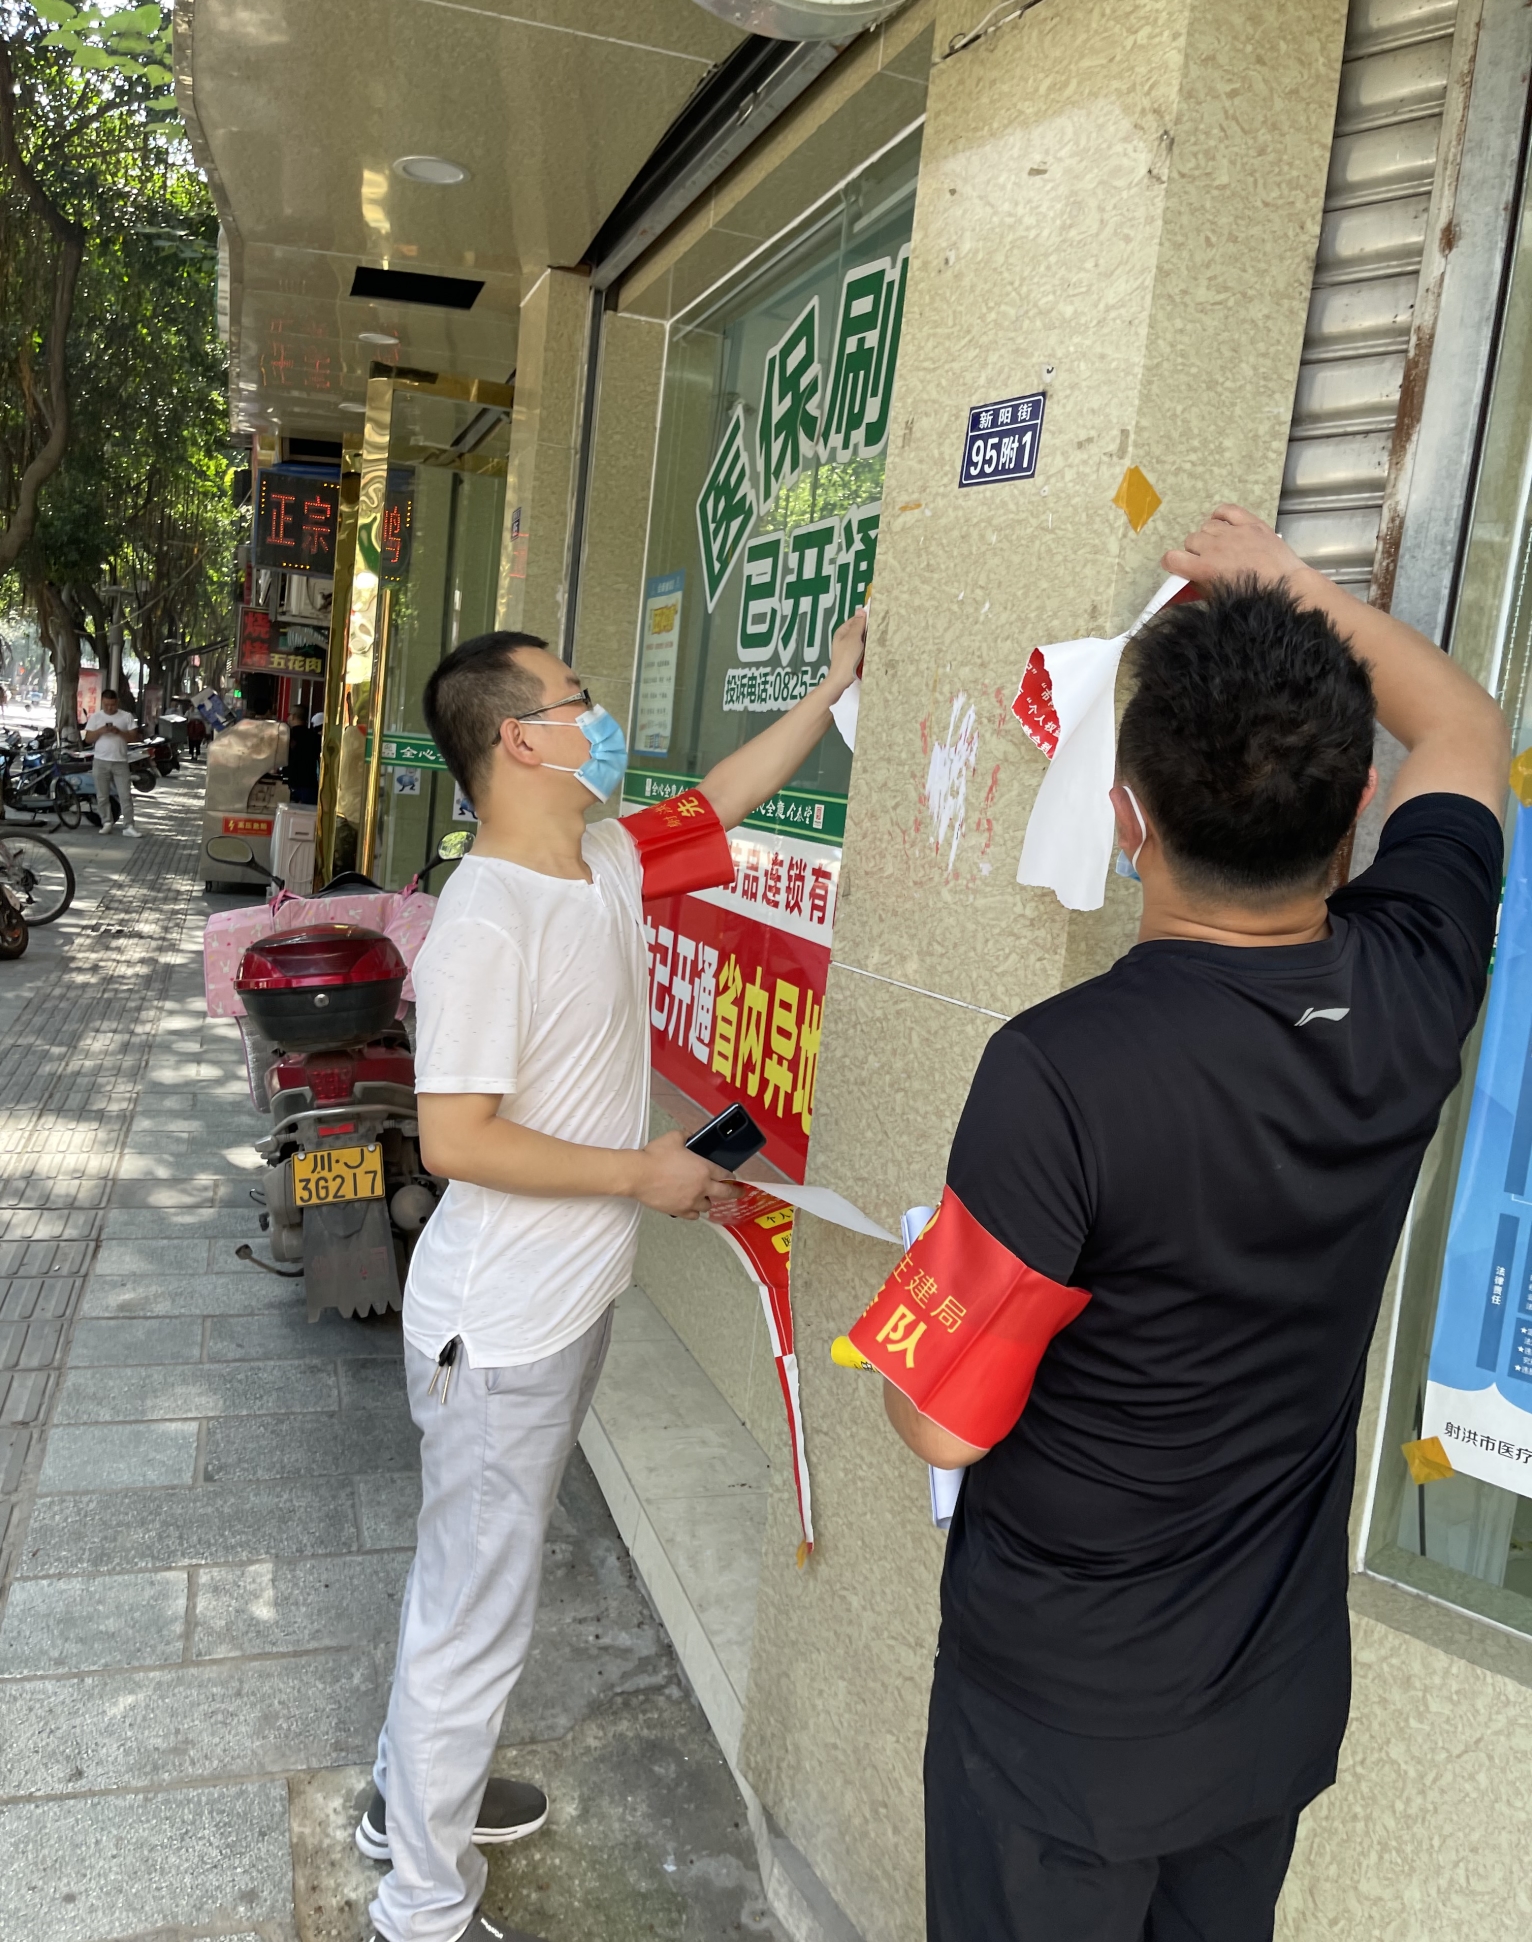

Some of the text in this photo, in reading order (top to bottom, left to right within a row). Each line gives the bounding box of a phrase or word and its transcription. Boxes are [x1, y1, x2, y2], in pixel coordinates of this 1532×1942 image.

[698, 256, 909, 604] 医保刷
[978, 403, 1033, 429] 新阳街
[969, 431, 1033, 476] 95附1
[266, 494, 332, 555] 正宗
[242, 611, 271, 668] 烧烤
[269, 653, 323, 674] 五花肉
[298, 1170, 378, 1204] 3G217
